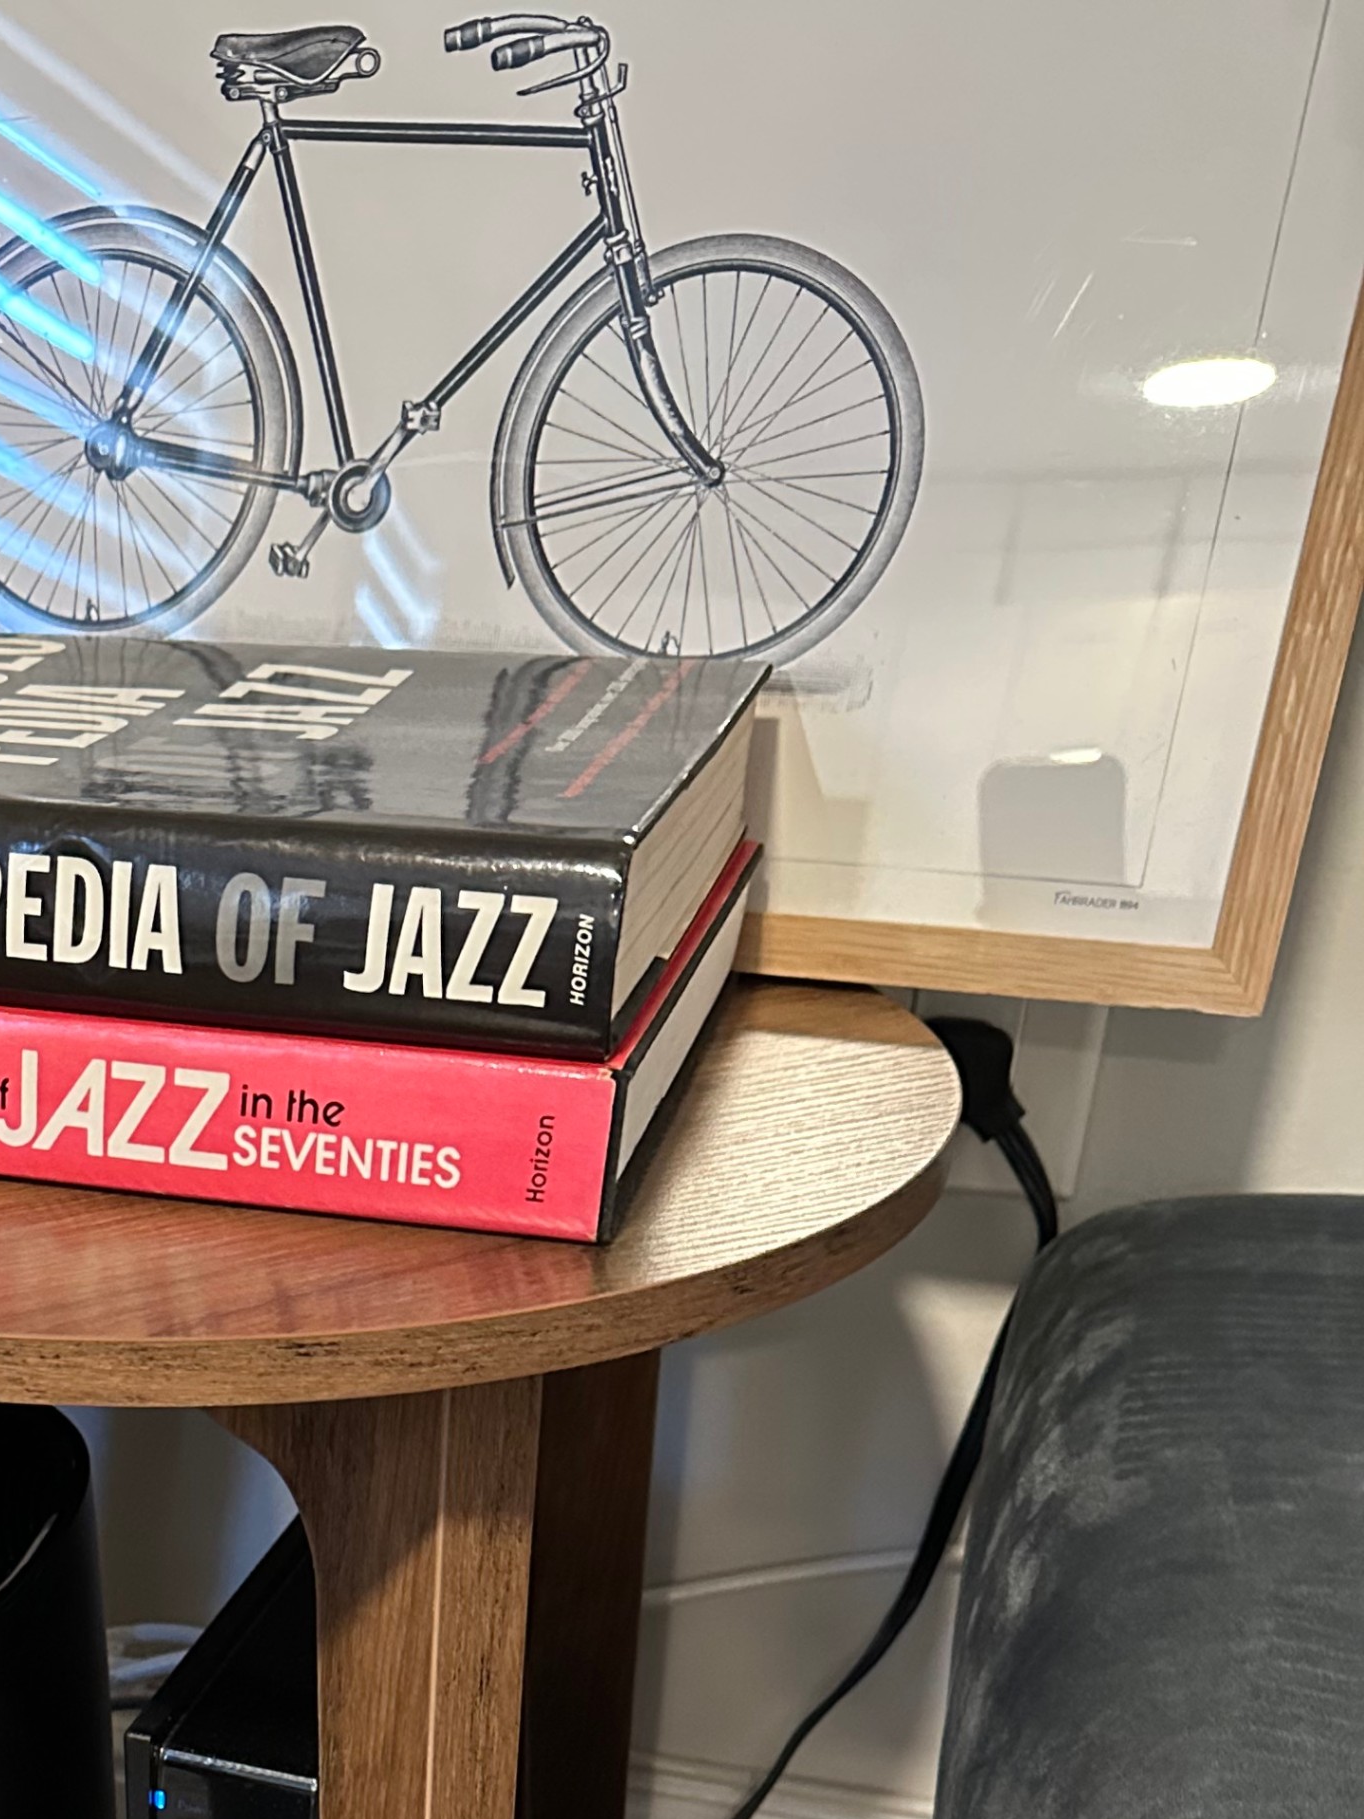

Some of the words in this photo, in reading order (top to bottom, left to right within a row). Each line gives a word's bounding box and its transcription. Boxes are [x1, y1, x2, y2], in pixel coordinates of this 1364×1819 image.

[172, 662, 416, 741] JAZZ
[215, 872, 327, 985] OF
[343, 883, 559, 1009] JAZZ
[569, 913, 595, 1006] HORIZON
[240, 1083, 274, 1120] in
[285, 1090, 346, 1127] the
[232, 1125, 462, 1190] SEVENTIES
[525, 1114, 555, 1204] Horizon
